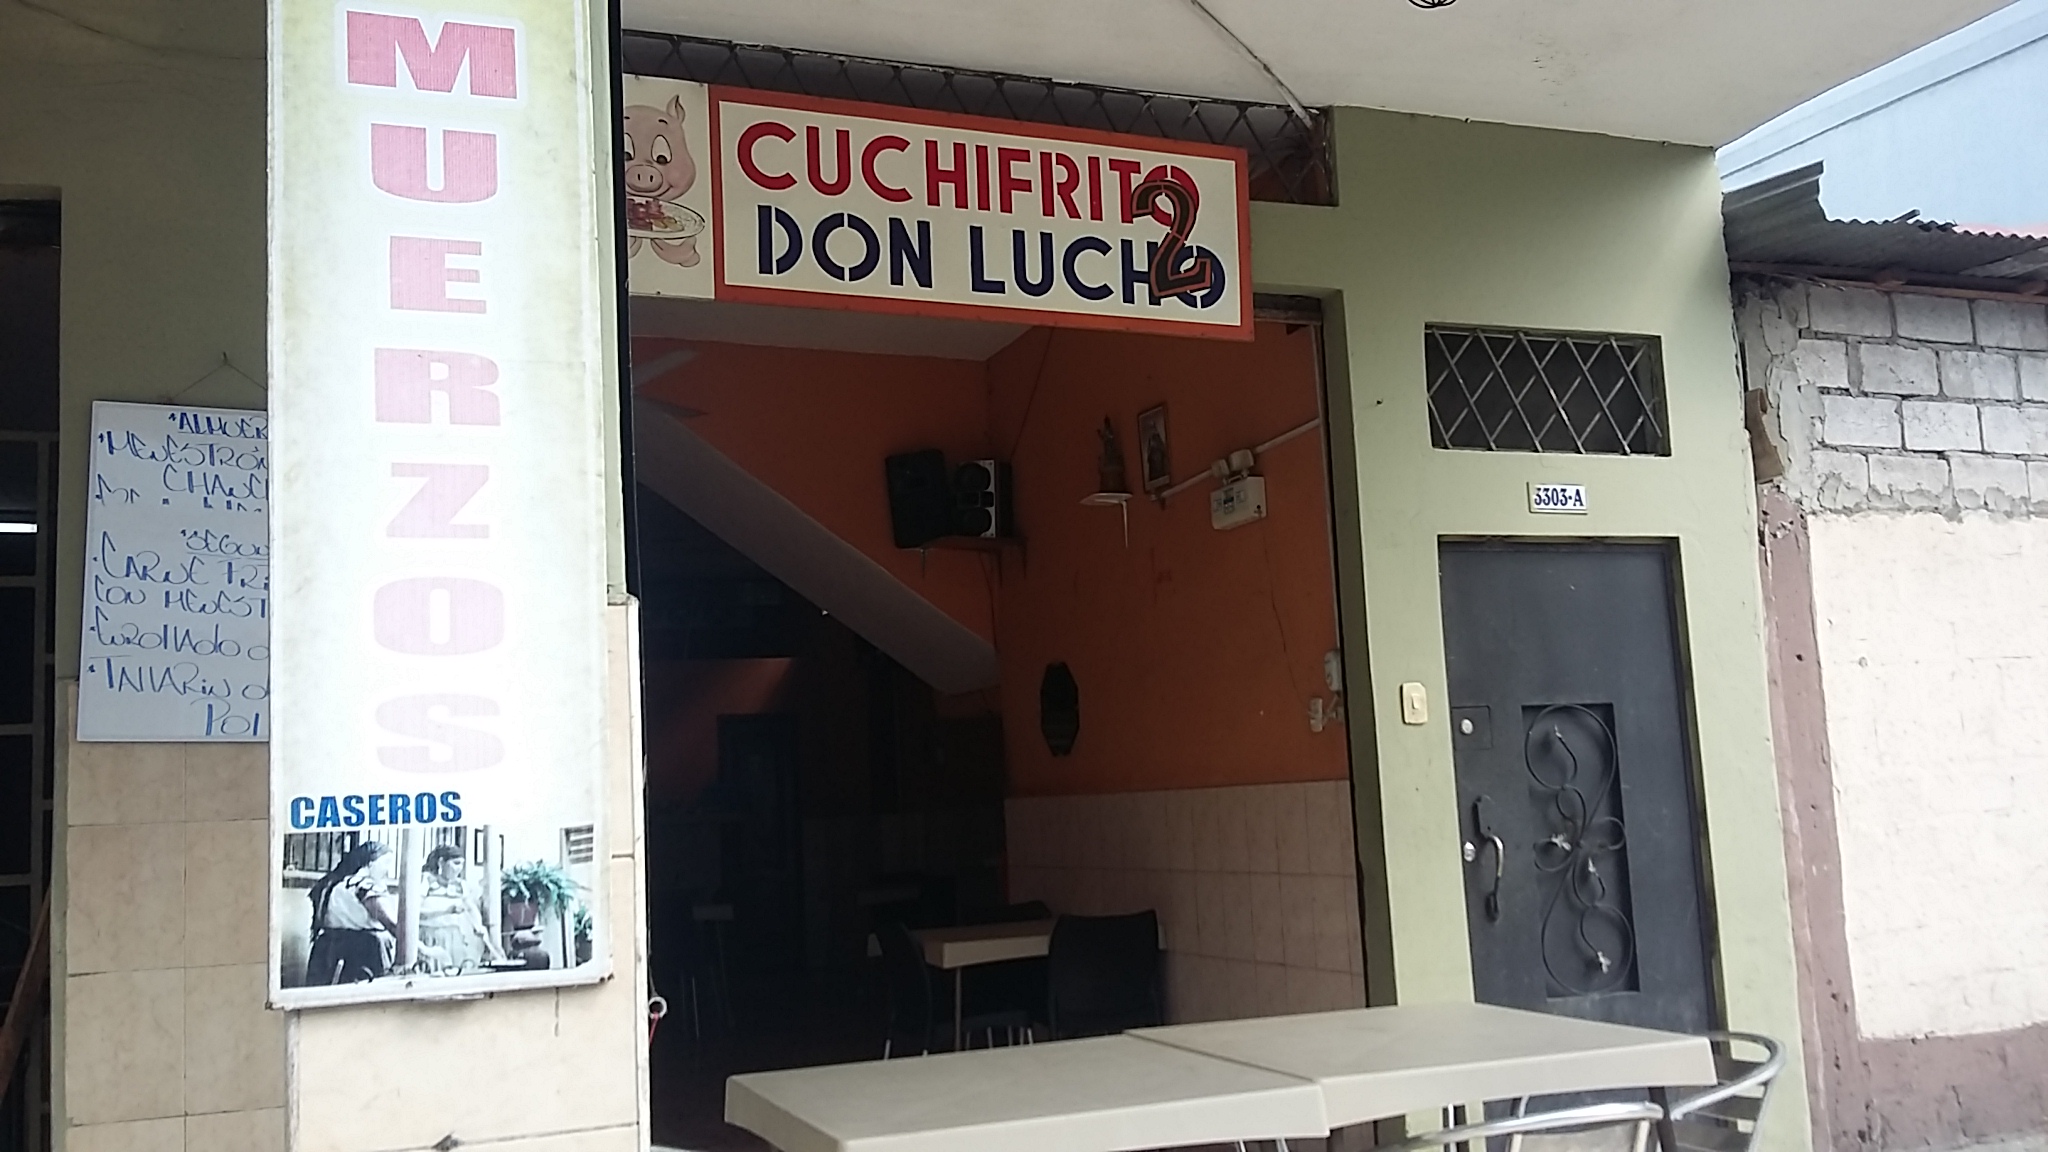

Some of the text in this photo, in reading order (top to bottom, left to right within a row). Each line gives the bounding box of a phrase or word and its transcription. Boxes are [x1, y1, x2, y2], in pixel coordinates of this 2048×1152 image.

[737, 121, 1200, 226] CUCHIFRITO
[757, 204, 1226, 309] DON LUCHO
[1131, 179, 1212, 298] 2
[346, 10, 517, 773] MUERZOS
[95, 575, 147, 605] CON
[102, 531, 209, 585] CARNE
[290, 791, 462, 829] CASEROS
